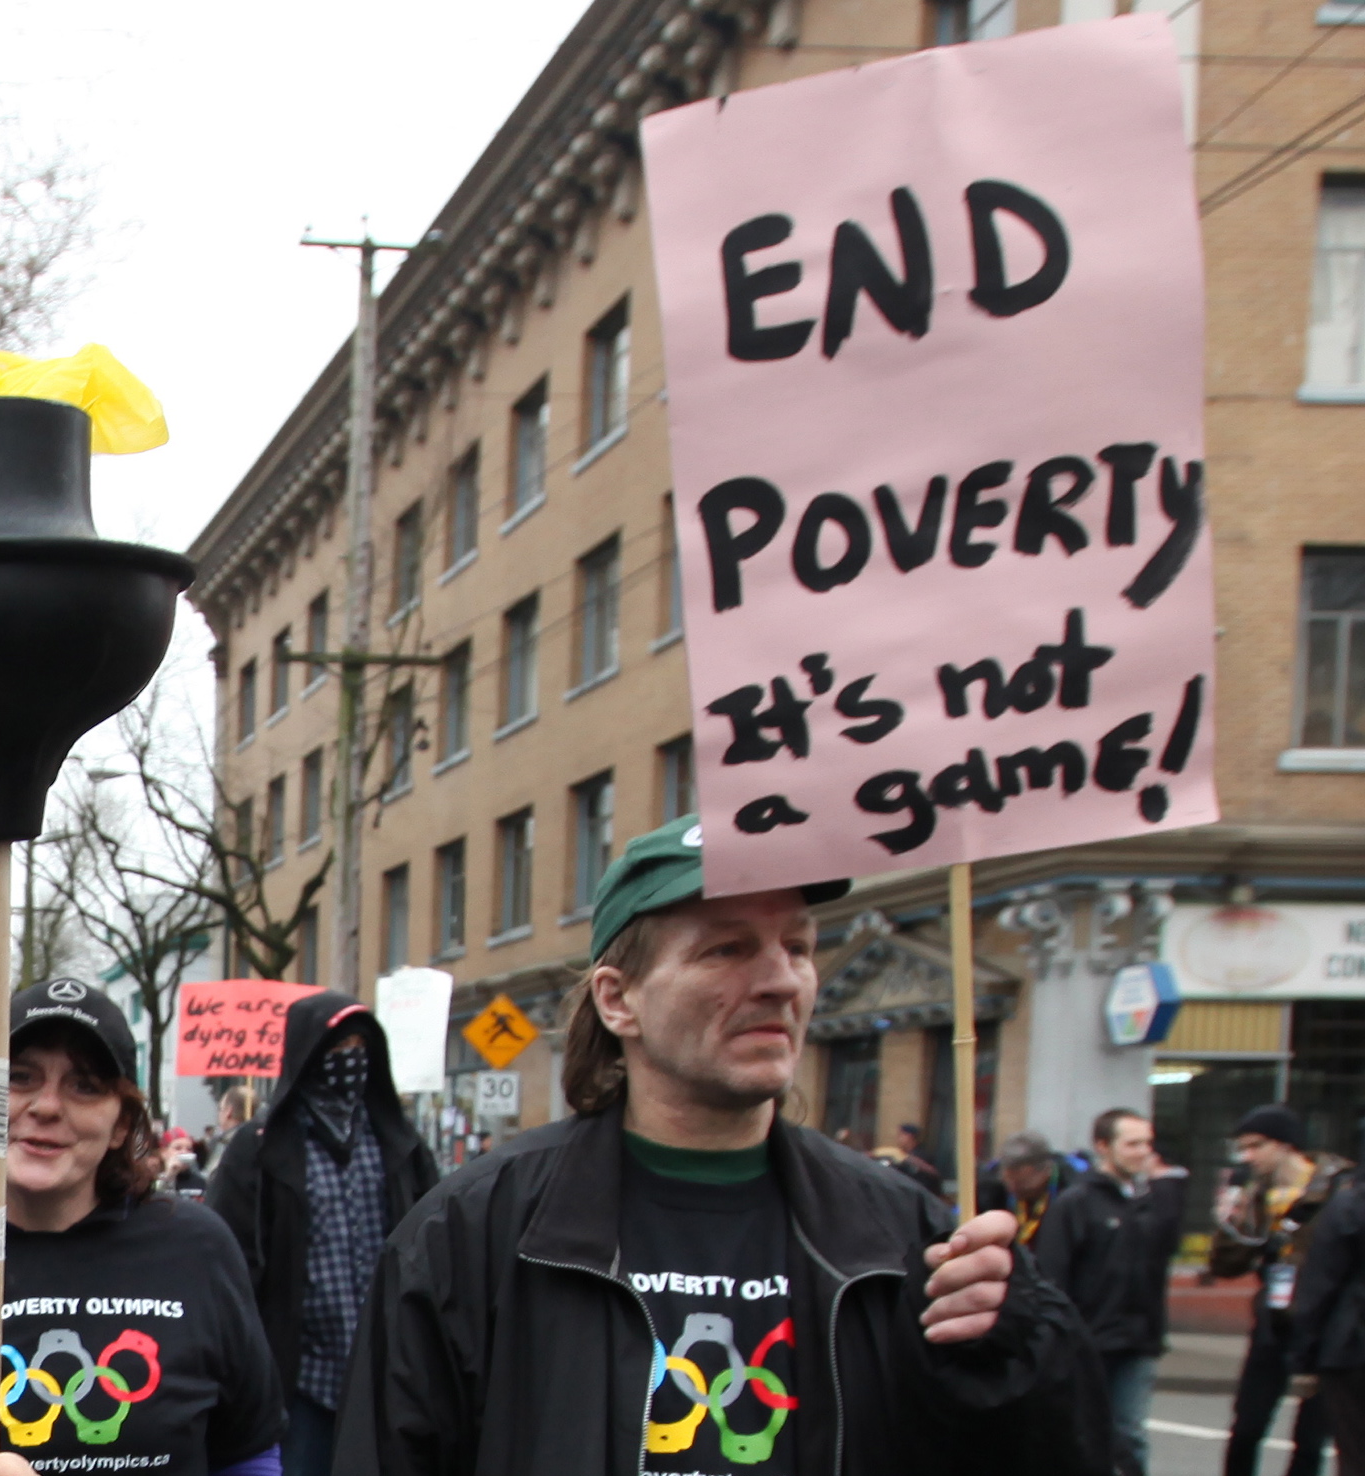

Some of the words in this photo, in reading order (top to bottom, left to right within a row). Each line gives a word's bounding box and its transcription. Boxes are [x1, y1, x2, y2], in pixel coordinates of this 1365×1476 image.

[721, 179, 1070, 361] END
[698, 442, 1203, 611] POVERTY
[705, 652, 904, 765] It's
[937, 607, 1115, 720] not
[734, 795, 809, 834] a
[187, 995, 225, 1016] We
[237, 998, 286, 1017] are
[184, 1022, 247, 1048] dying
[256, 1021, 281, 1045] fo
[483, 1078, 513, 1098] 30
[628, 1271, 735, 1298] OVERTY
[0, 1297, 80, 1320] OVERTY
[85, 1297, 184, 1319] OLYMPICS
